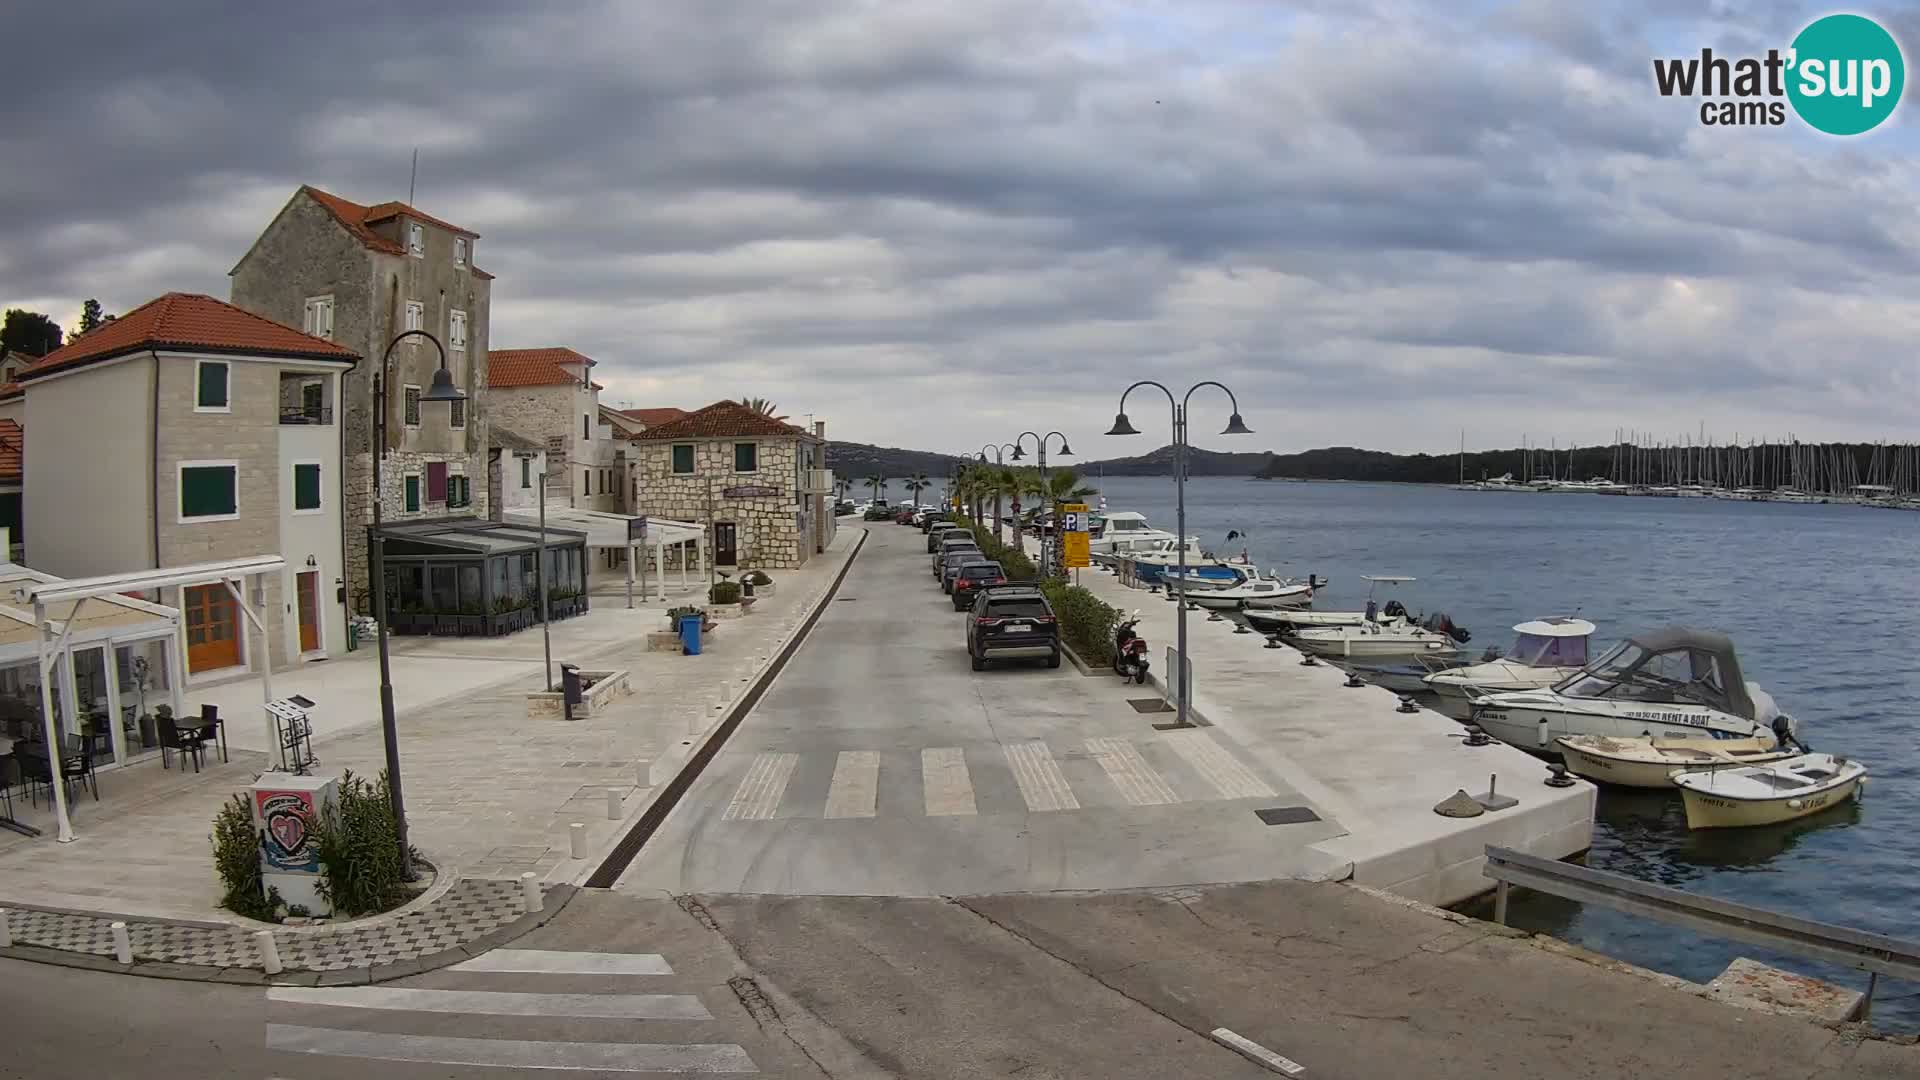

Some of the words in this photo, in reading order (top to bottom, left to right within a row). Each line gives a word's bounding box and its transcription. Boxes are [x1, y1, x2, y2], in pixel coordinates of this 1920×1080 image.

[1065, 514, 1077, 530] P
[1661, 712, 1683, 723] RENT
[1684, 713, 1689, 724] A
[1690, 714, 1710, 727] BOAT
